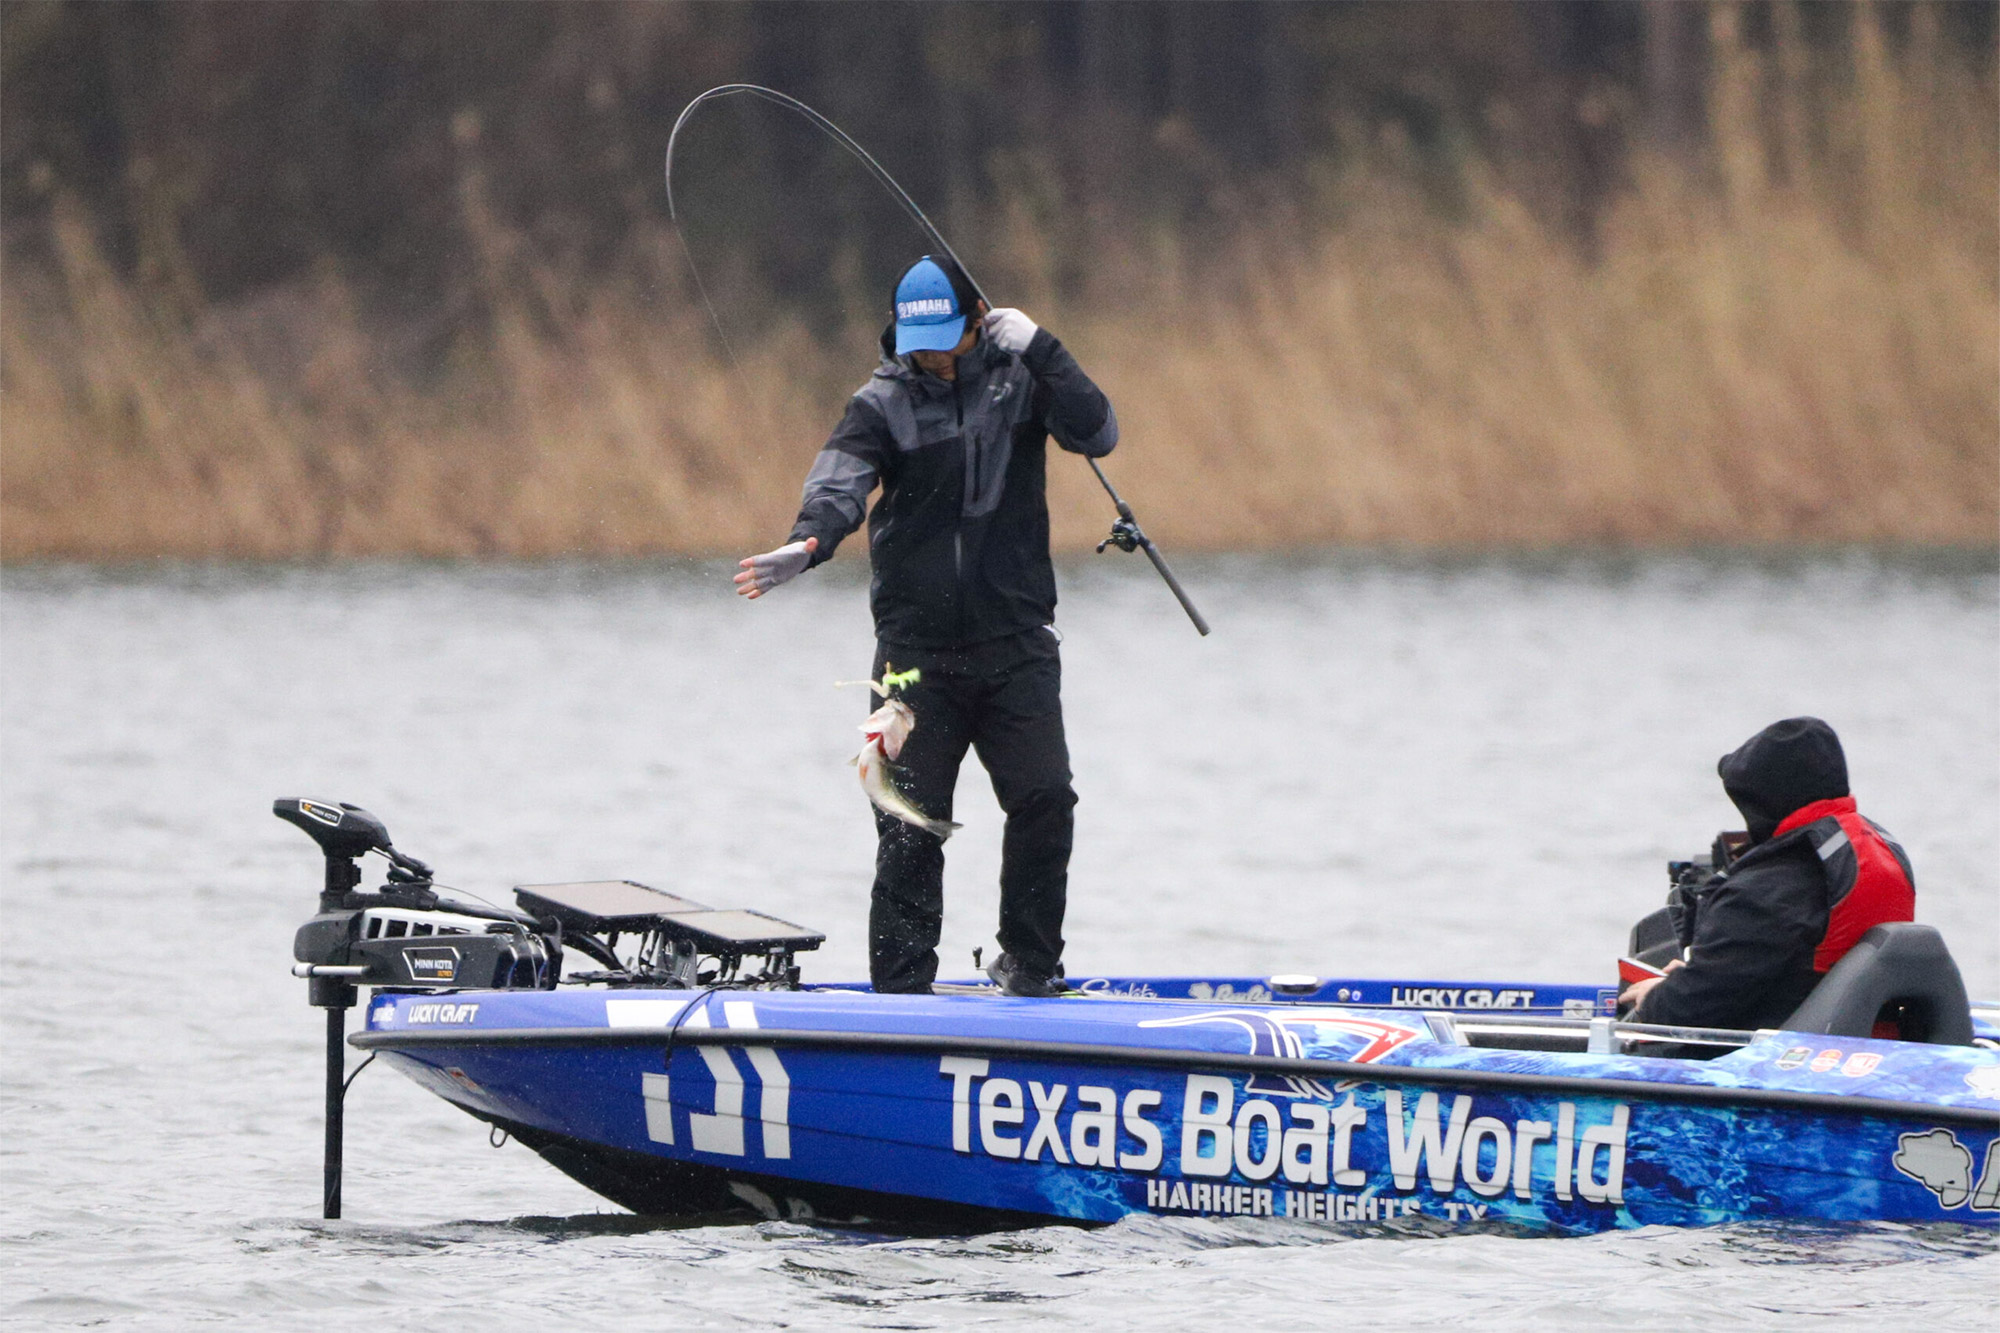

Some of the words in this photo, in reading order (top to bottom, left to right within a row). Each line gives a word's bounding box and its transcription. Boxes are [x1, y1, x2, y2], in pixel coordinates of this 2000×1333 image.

[905, 298, 951, 315] YAMAHA
[414, 958, 433, 969] MINN
[434, 959, 453, 970] KOTA
[1391, 987, 1461, 1007] LUCKY
[1463, 989, 1534, 1009] CRAFT
[408, 1004, 441, 1023] LUCKY
[440, 1003, 479, 1023] CRAFT
[939, 1056, 1161, 1171] Texas
[1180, 1073, 1366, 1187] Boat
[1386, 1089, 1630, 1205] World
[1146, 1179, 1273, 1217] HARKER
